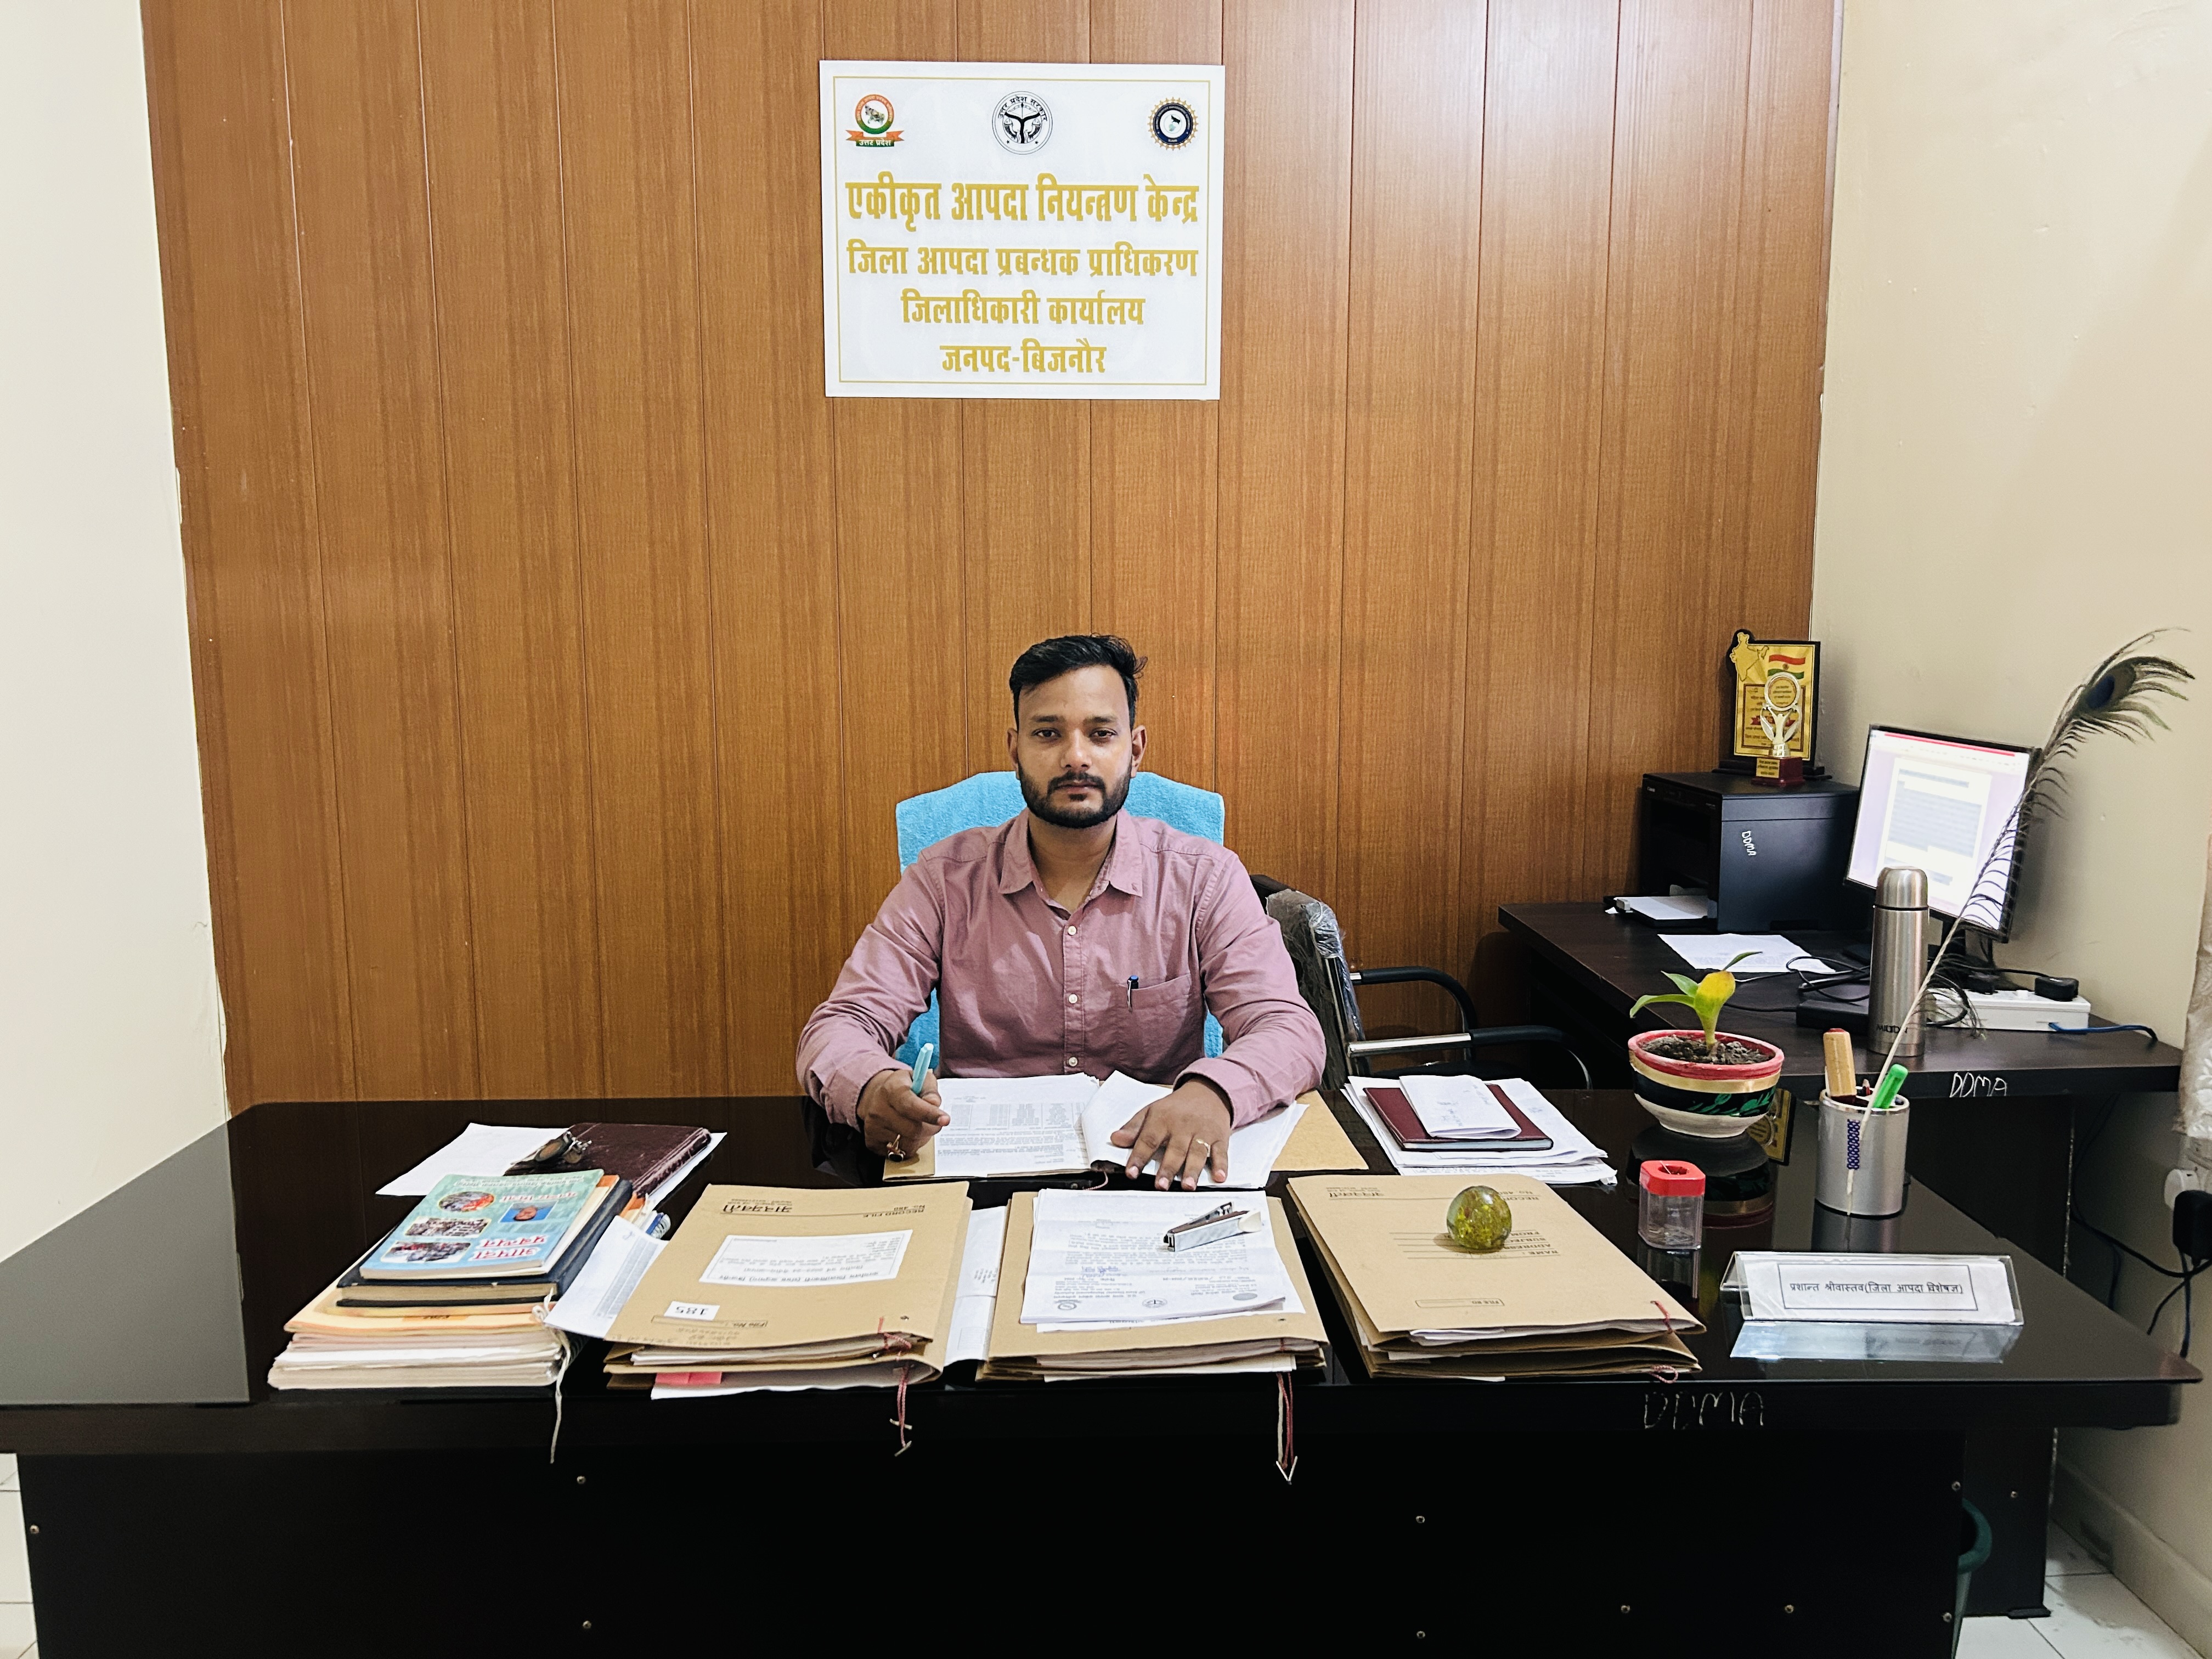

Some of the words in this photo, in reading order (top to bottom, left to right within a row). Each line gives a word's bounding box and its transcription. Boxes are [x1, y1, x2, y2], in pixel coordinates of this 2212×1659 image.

[997, 103, 1010, 119] उत्तर
[1009, 95, 1028, 103] प्रदेश
[1030, 99, 1048, 121] सरकार
[876, 138, 891, 146] प्रदेश
[845, 171, 941, 232] एकीकृत
[952, 182, 1028, 221] आपदा
[1143, 174, 1199, 224] केन्द्र
[847, 239, 909, 274] जिला
[918, 247, 989, 275] आपदा
[996, 248, 1080, 276] प्रबन्धक
[1087, 241, 1199, 276] प्राधिकरण
[901, 288, 1040, 324] जिलाधिकारी
[1047, 290, 1146, 325] कार्यालय
[940, 338, 1107, 373] जनपद-बिजनौर
[1741, 830, 1757, 856] DDMA
[1949, 1072, 2007, 1098] DDMA
[473, 1248, 538, 1260] आपदा
[1789, 1282, 1820, 1292] प्रशान्त
[1897, 1283, 1923, 1293] आपदा
[675, 1306, 709, 1316] 185
